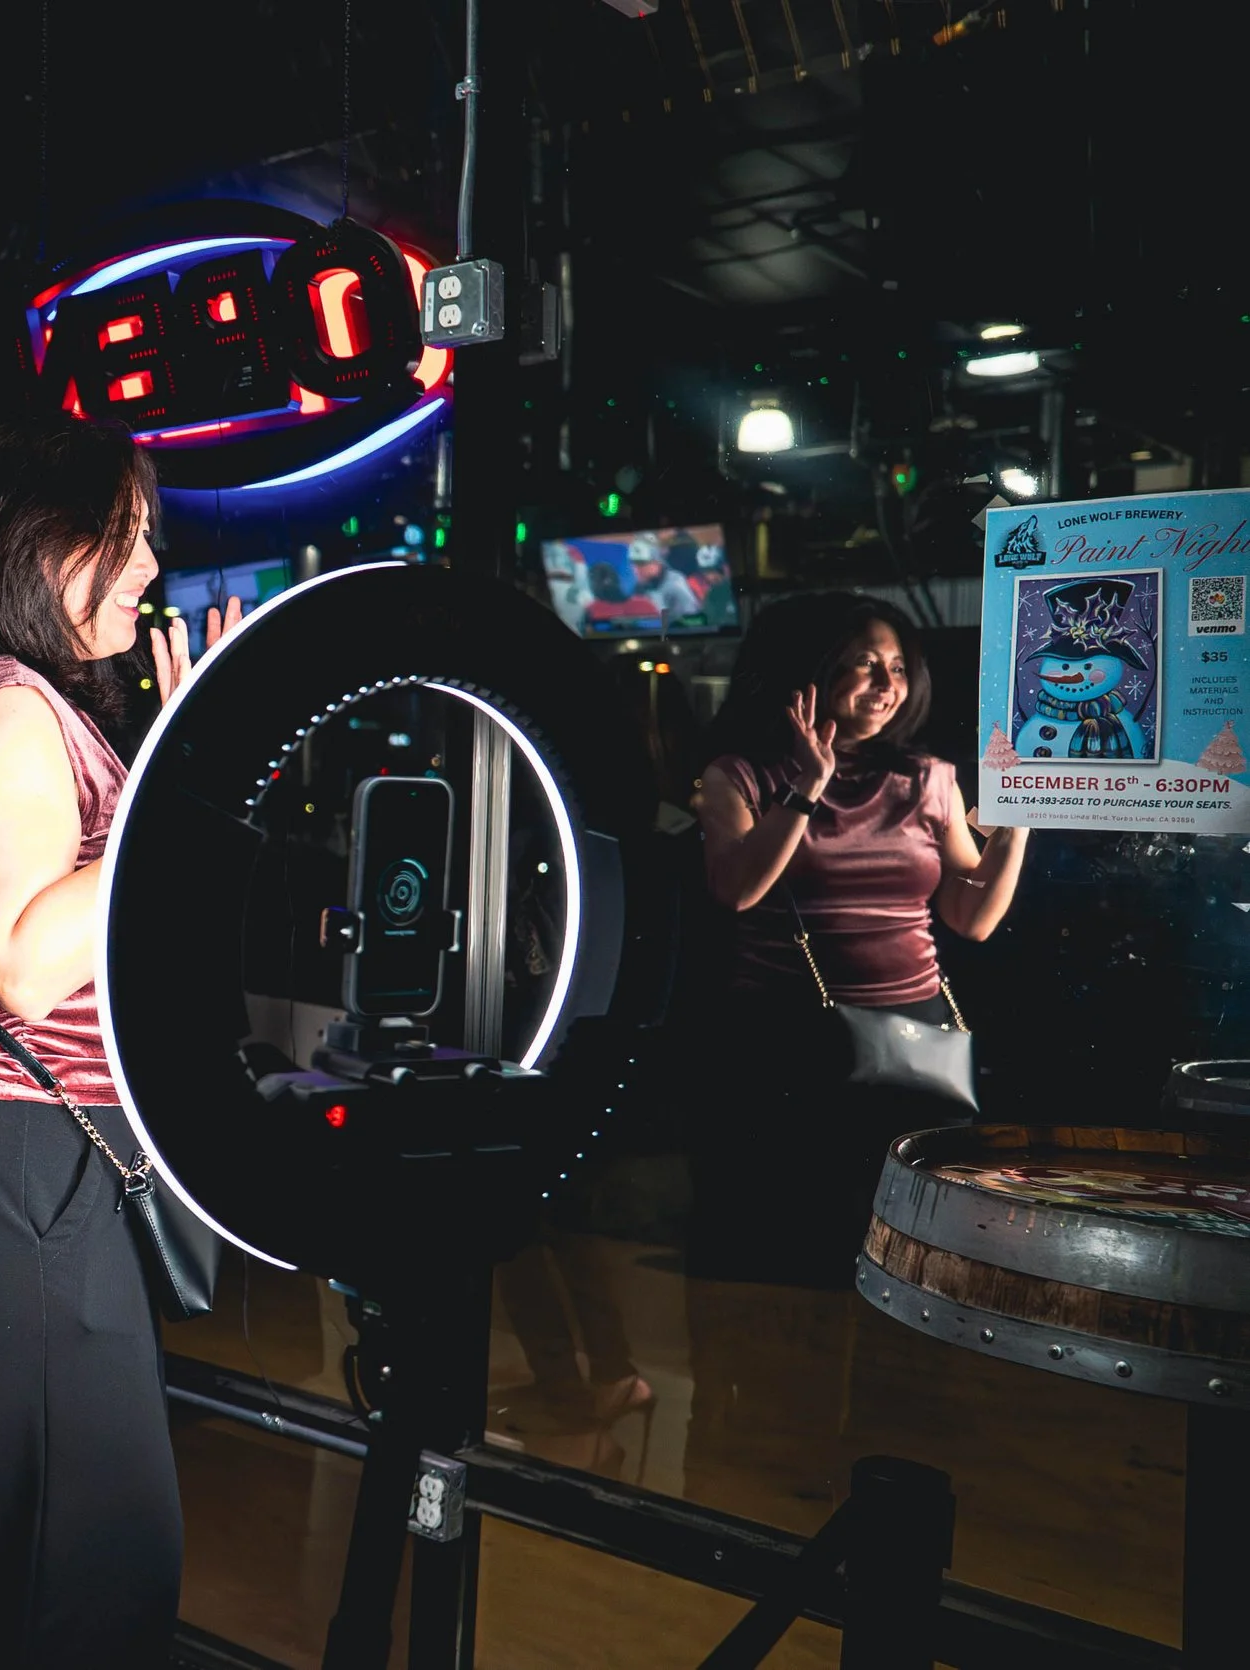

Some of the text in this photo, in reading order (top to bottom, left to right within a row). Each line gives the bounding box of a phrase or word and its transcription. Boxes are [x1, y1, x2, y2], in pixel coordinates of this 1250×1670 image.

[1057, 509, 1184, 529] LONE WOLF BREWERY
[1050, 534, 1150, 566] Paint
[1196, 625, 1237, 634] venmo
[1201, 650, 1228, 664] $35
[1191, 675, 1238, 684] INCLUDES
[1189, 686, 1239, 695] MATERIALS
[1203, 697, 1225, 705] AND
[1182, 708, 1243, 716] INSTRUCTION
[1001, 775, 1100, 791] DECEMBER
[1103, 774, 1139, 792] 16th
[1155, 777, 1231, 793] 6:30PM
[997, 795, 1234, 810] CALL 714-393-2501 TO PURCHASE YOUR SEATS.
